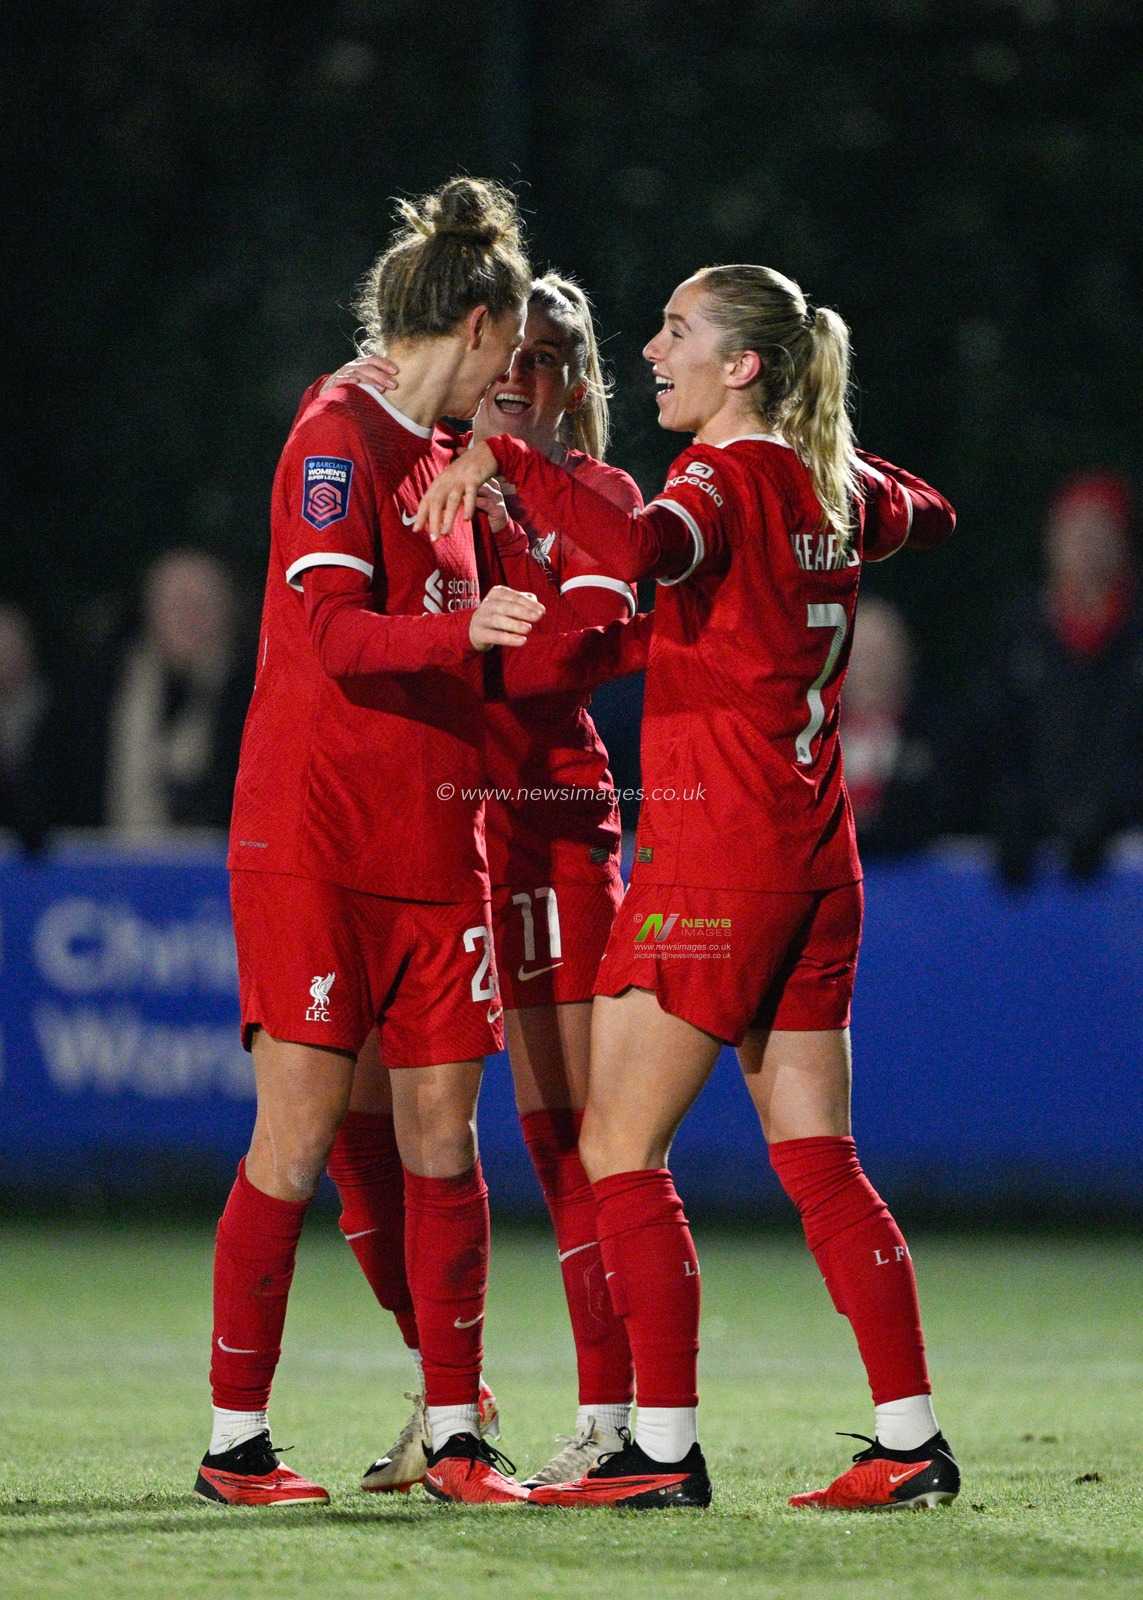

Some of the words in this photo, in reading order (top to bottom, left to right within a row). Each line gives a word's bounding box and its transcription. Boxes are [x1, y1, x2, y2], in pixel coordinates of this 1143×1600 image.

[316, 462, 348, 471] BARCLAYS
[308, 468, 347, 478] WOMEN'S
[325, 475, 346, 483] LEAGUE
[795, 603, 847, 763] 7
[512, 887, 562, 960] 11
